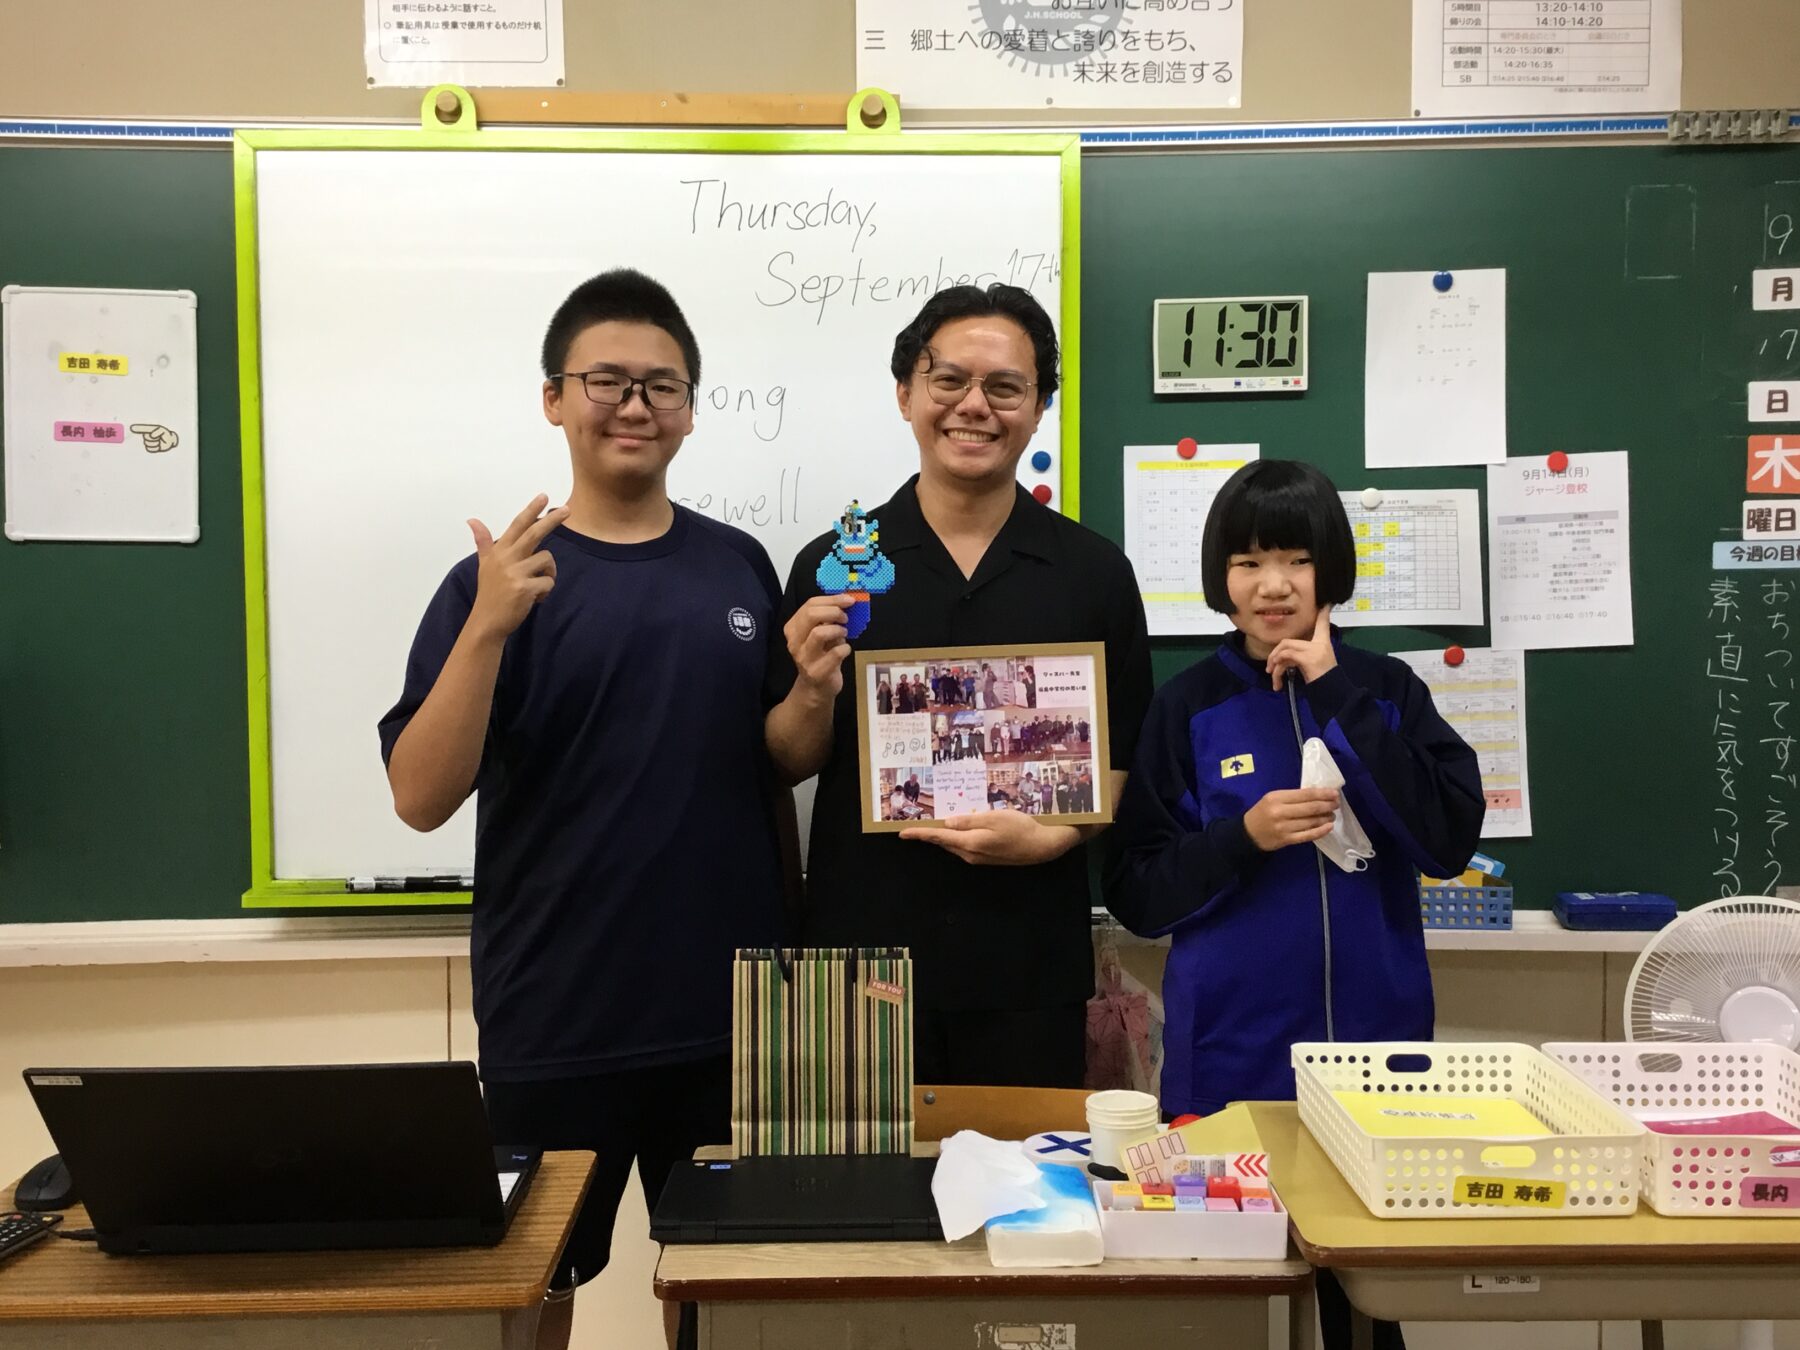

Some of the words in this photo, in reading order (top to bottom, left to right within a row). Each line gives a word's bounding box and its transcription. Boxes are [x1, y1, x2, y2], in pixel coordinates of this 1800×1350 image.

[1536, 3, 1603, 12] 13:20-14:10
[1536, 17, 1603, 26] 14:10-14:20
[864, 30, 886, 50] 三
[910, 29, 1197, 52] 郷土への愛着と誇りをもち、
[1073, 61, 1234, 84] 未来を創造する
[680, 179, 877, 253] Thursday,
[1771, 276, 1793, 302] 月
[1183, 303, 1300, 368] 11:30
[1766, 389, 1789, 413] 日
[1752, 438, 1800, 488] 木
[1746, 507, 1796, 532] 曜日
[1730, 545, 1800, 562] 今週の目
[1466, 1181, 1504, 1200] 吉田
[1471, 1275, 1483, 1289] L
